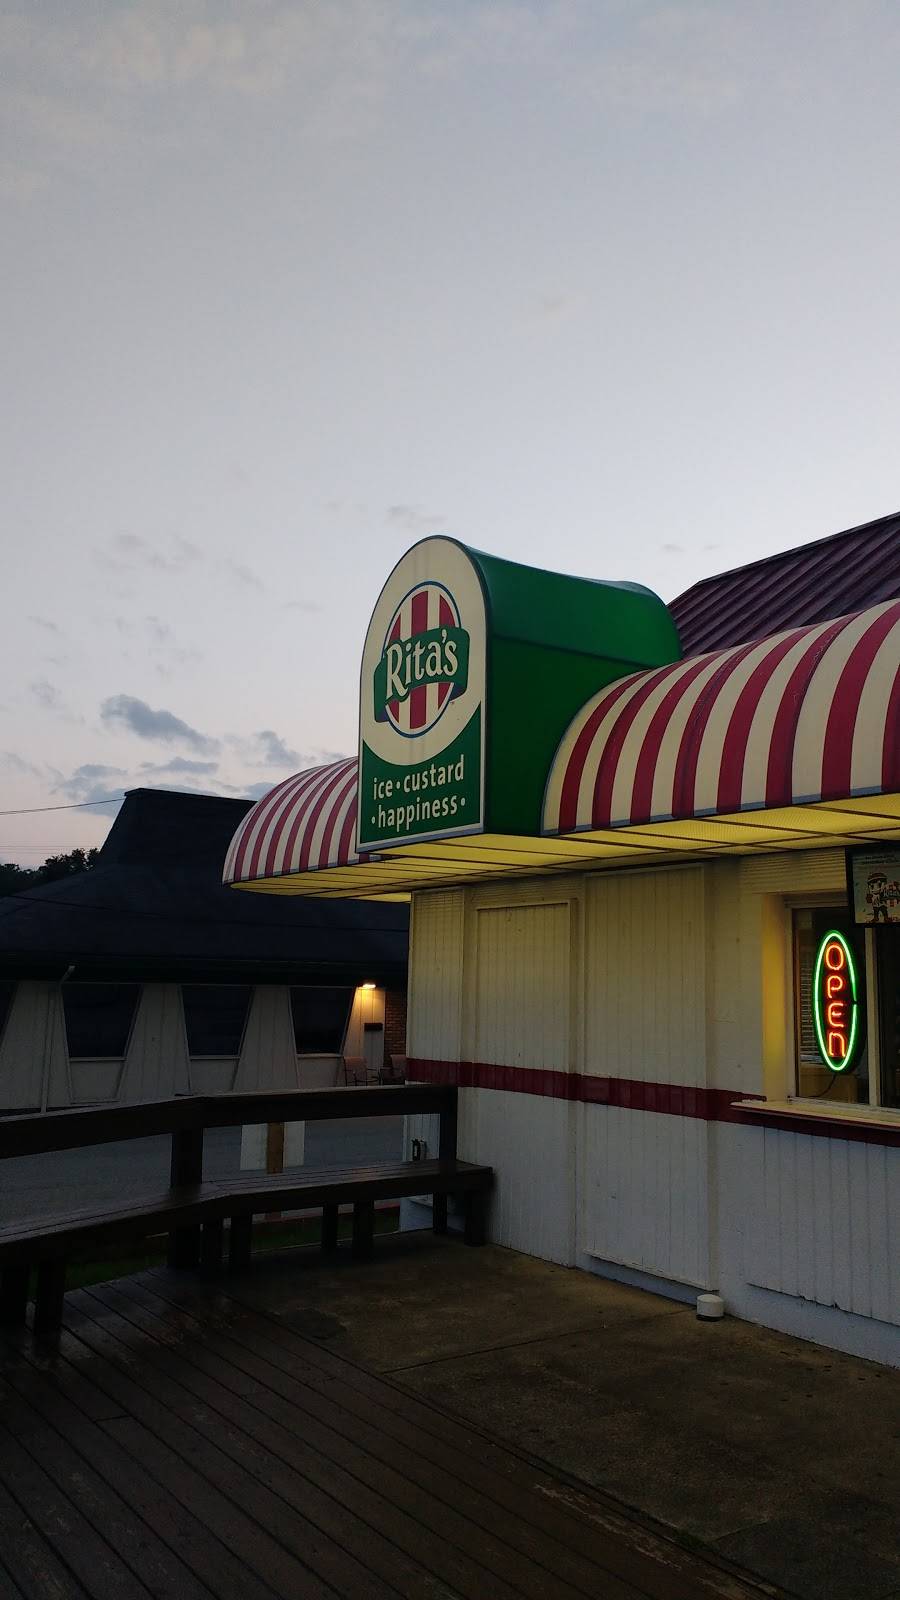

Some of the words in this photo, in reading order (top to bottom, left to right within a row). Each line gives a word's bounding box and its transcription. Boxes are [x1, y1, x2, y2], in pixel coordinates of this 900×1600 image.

[386, 629, 458, 697] Rita's
[373, 777, 393, 800] ice
[403, 754, 464, 793] custard
[378, 795, 458, 832] happiness
[824, 942, 847, 1059] OPEN
